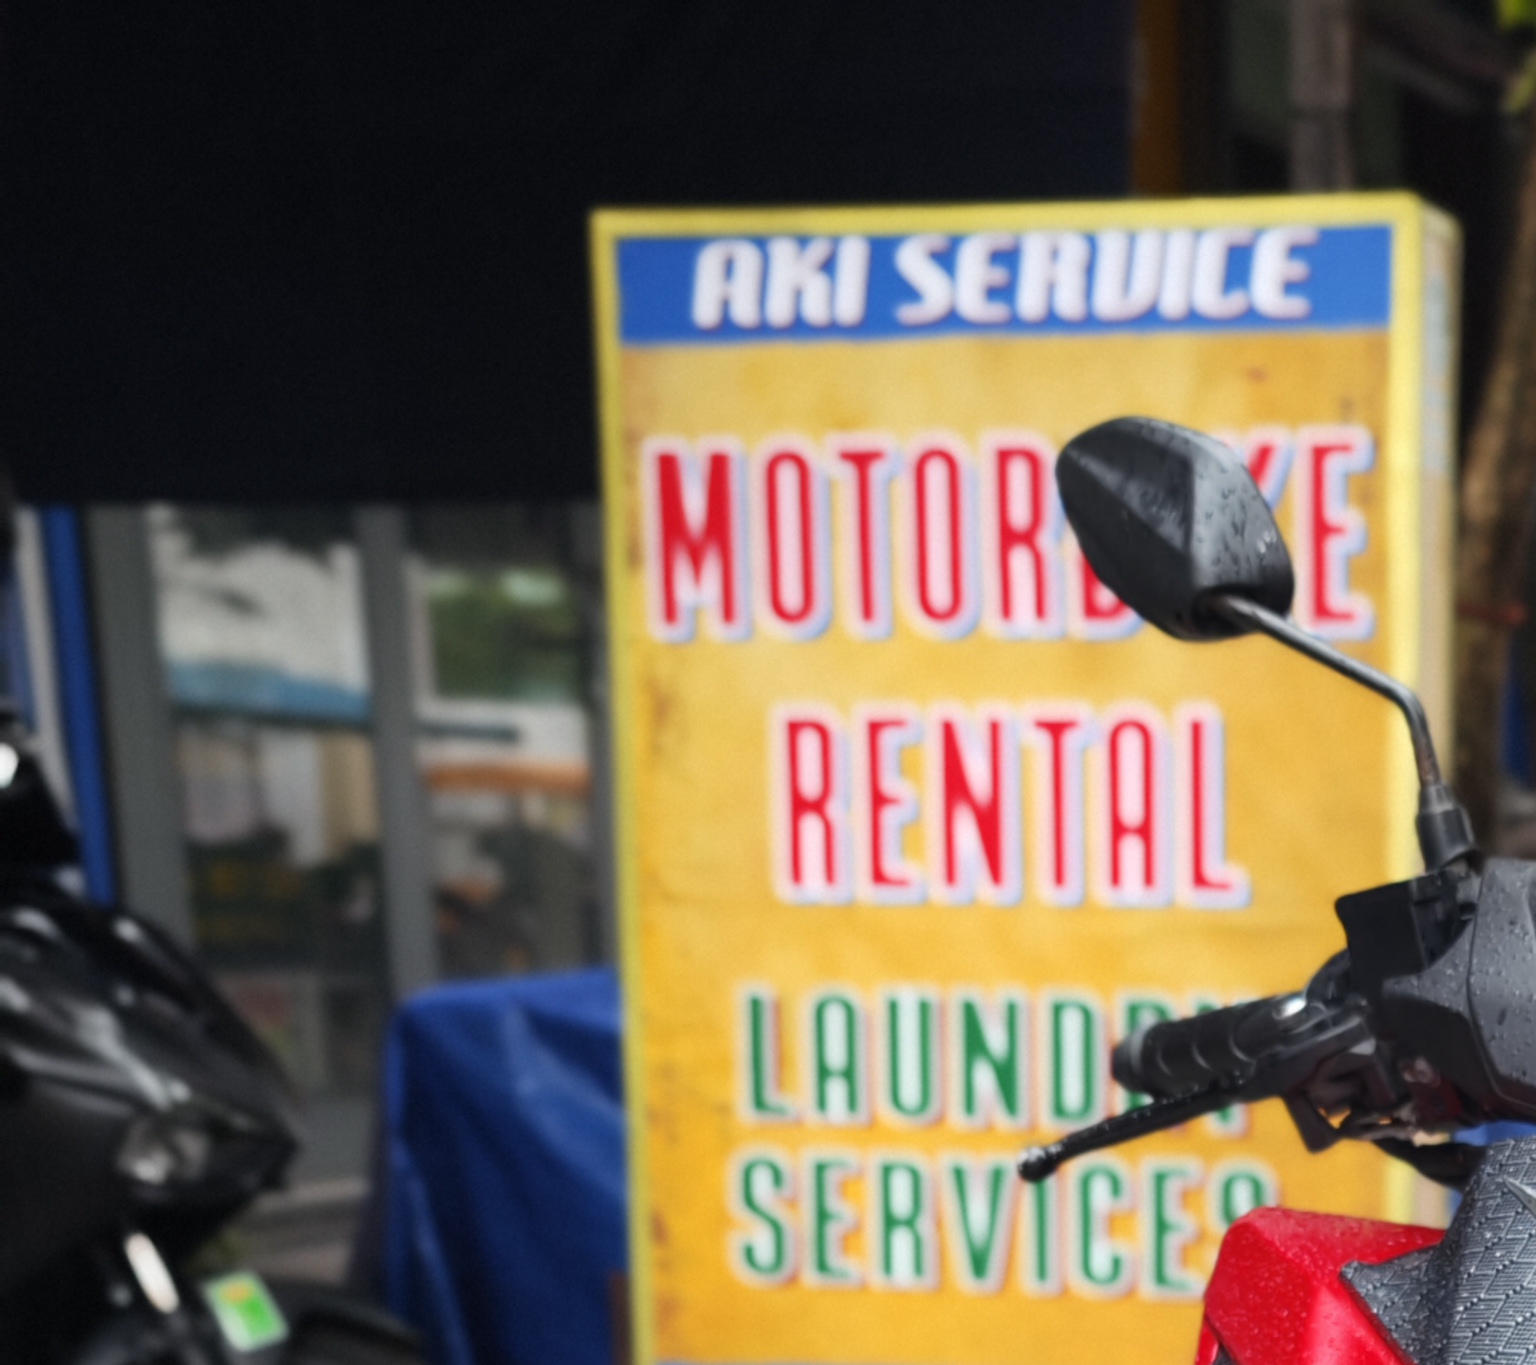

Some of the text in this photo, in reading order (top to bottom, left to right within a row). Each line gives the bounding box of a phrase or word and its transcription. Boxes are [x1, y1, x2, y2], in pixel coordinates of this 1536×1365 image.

[692, 225, 1322, 330] AKI SERVICE
[770, 702, 1250, 908] RENTAL
[735, 982, 1255, 1138] LAUND
